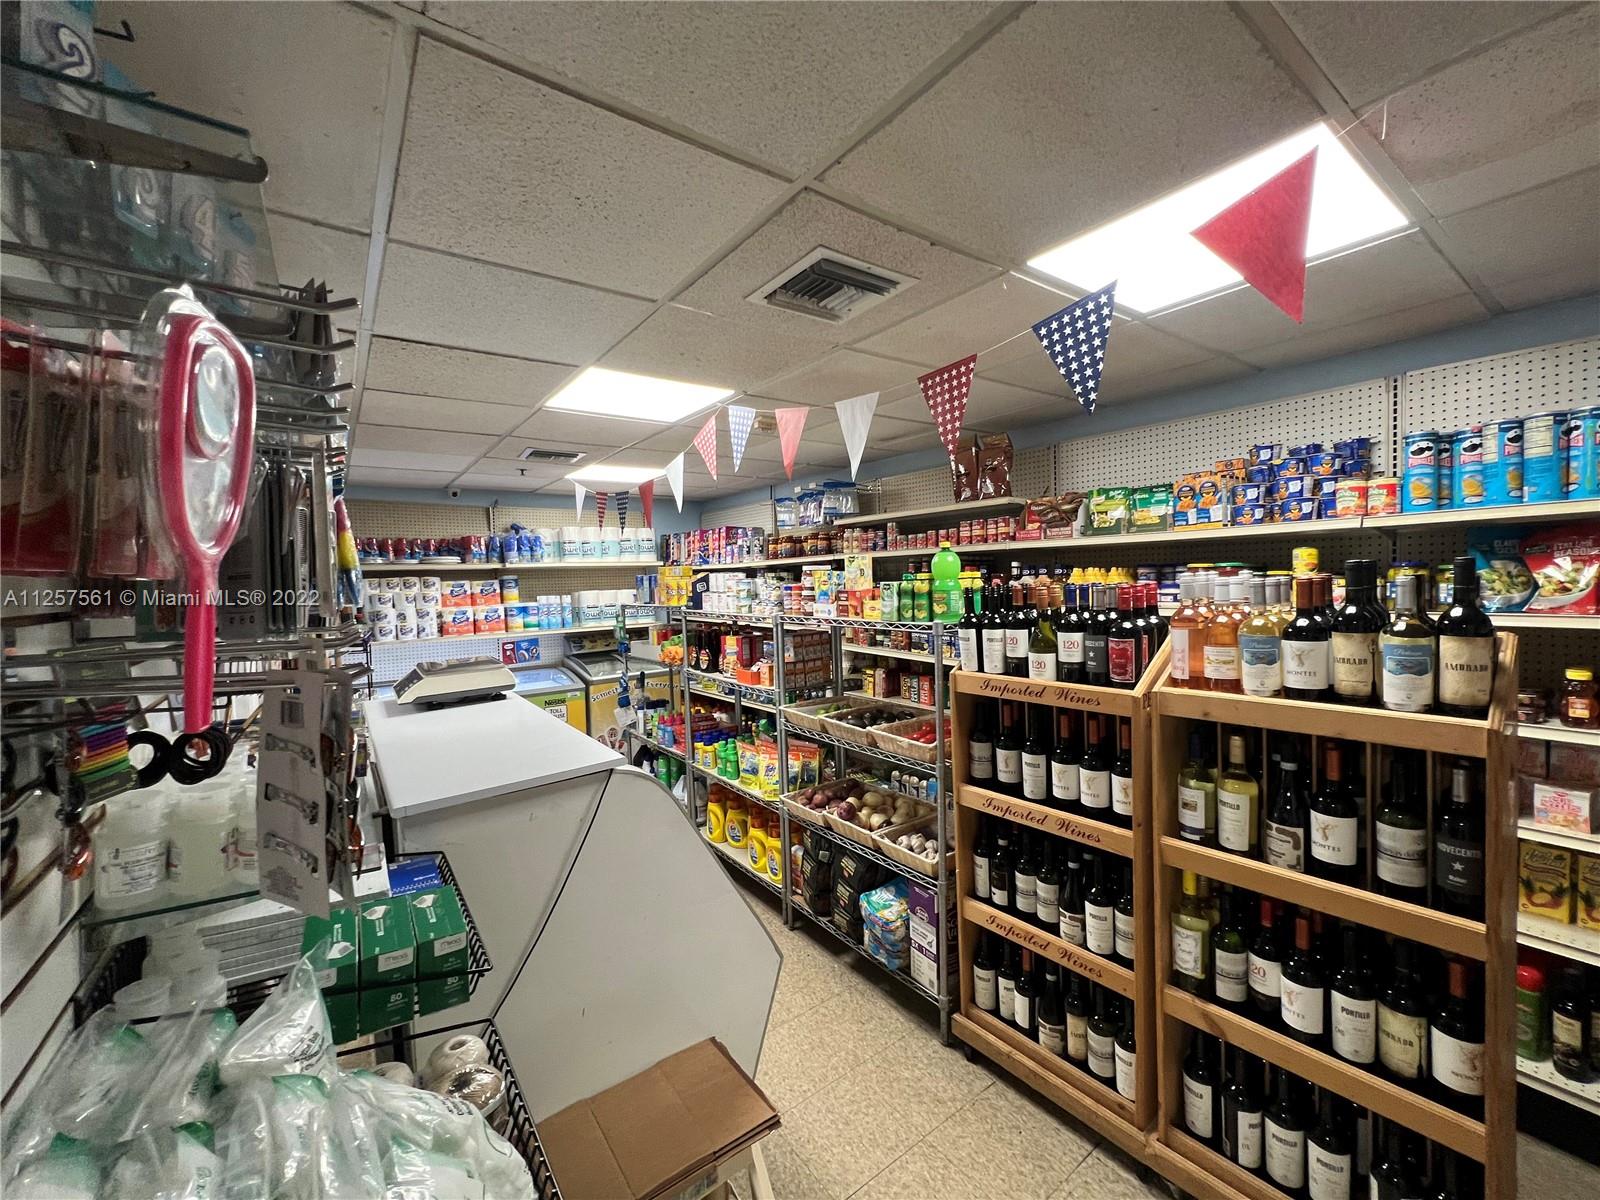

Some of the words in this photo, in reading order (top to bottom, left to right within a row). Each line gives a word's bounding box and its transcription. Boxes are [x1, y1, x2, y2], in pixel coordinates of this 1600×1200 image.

[1062, 640, 1079, 649] 120
[1031, 660, 1046, 670] 120
[980, 679, 1047, 699] Imported
[1054, 688, 1101, 706] Wines
[982, 797, 1049, 826] Imported
[1055, 817, 1102, 843] Wines
[986, 914, 1050, 951] Imported
[1057, 947, 1104, 979] Wines
